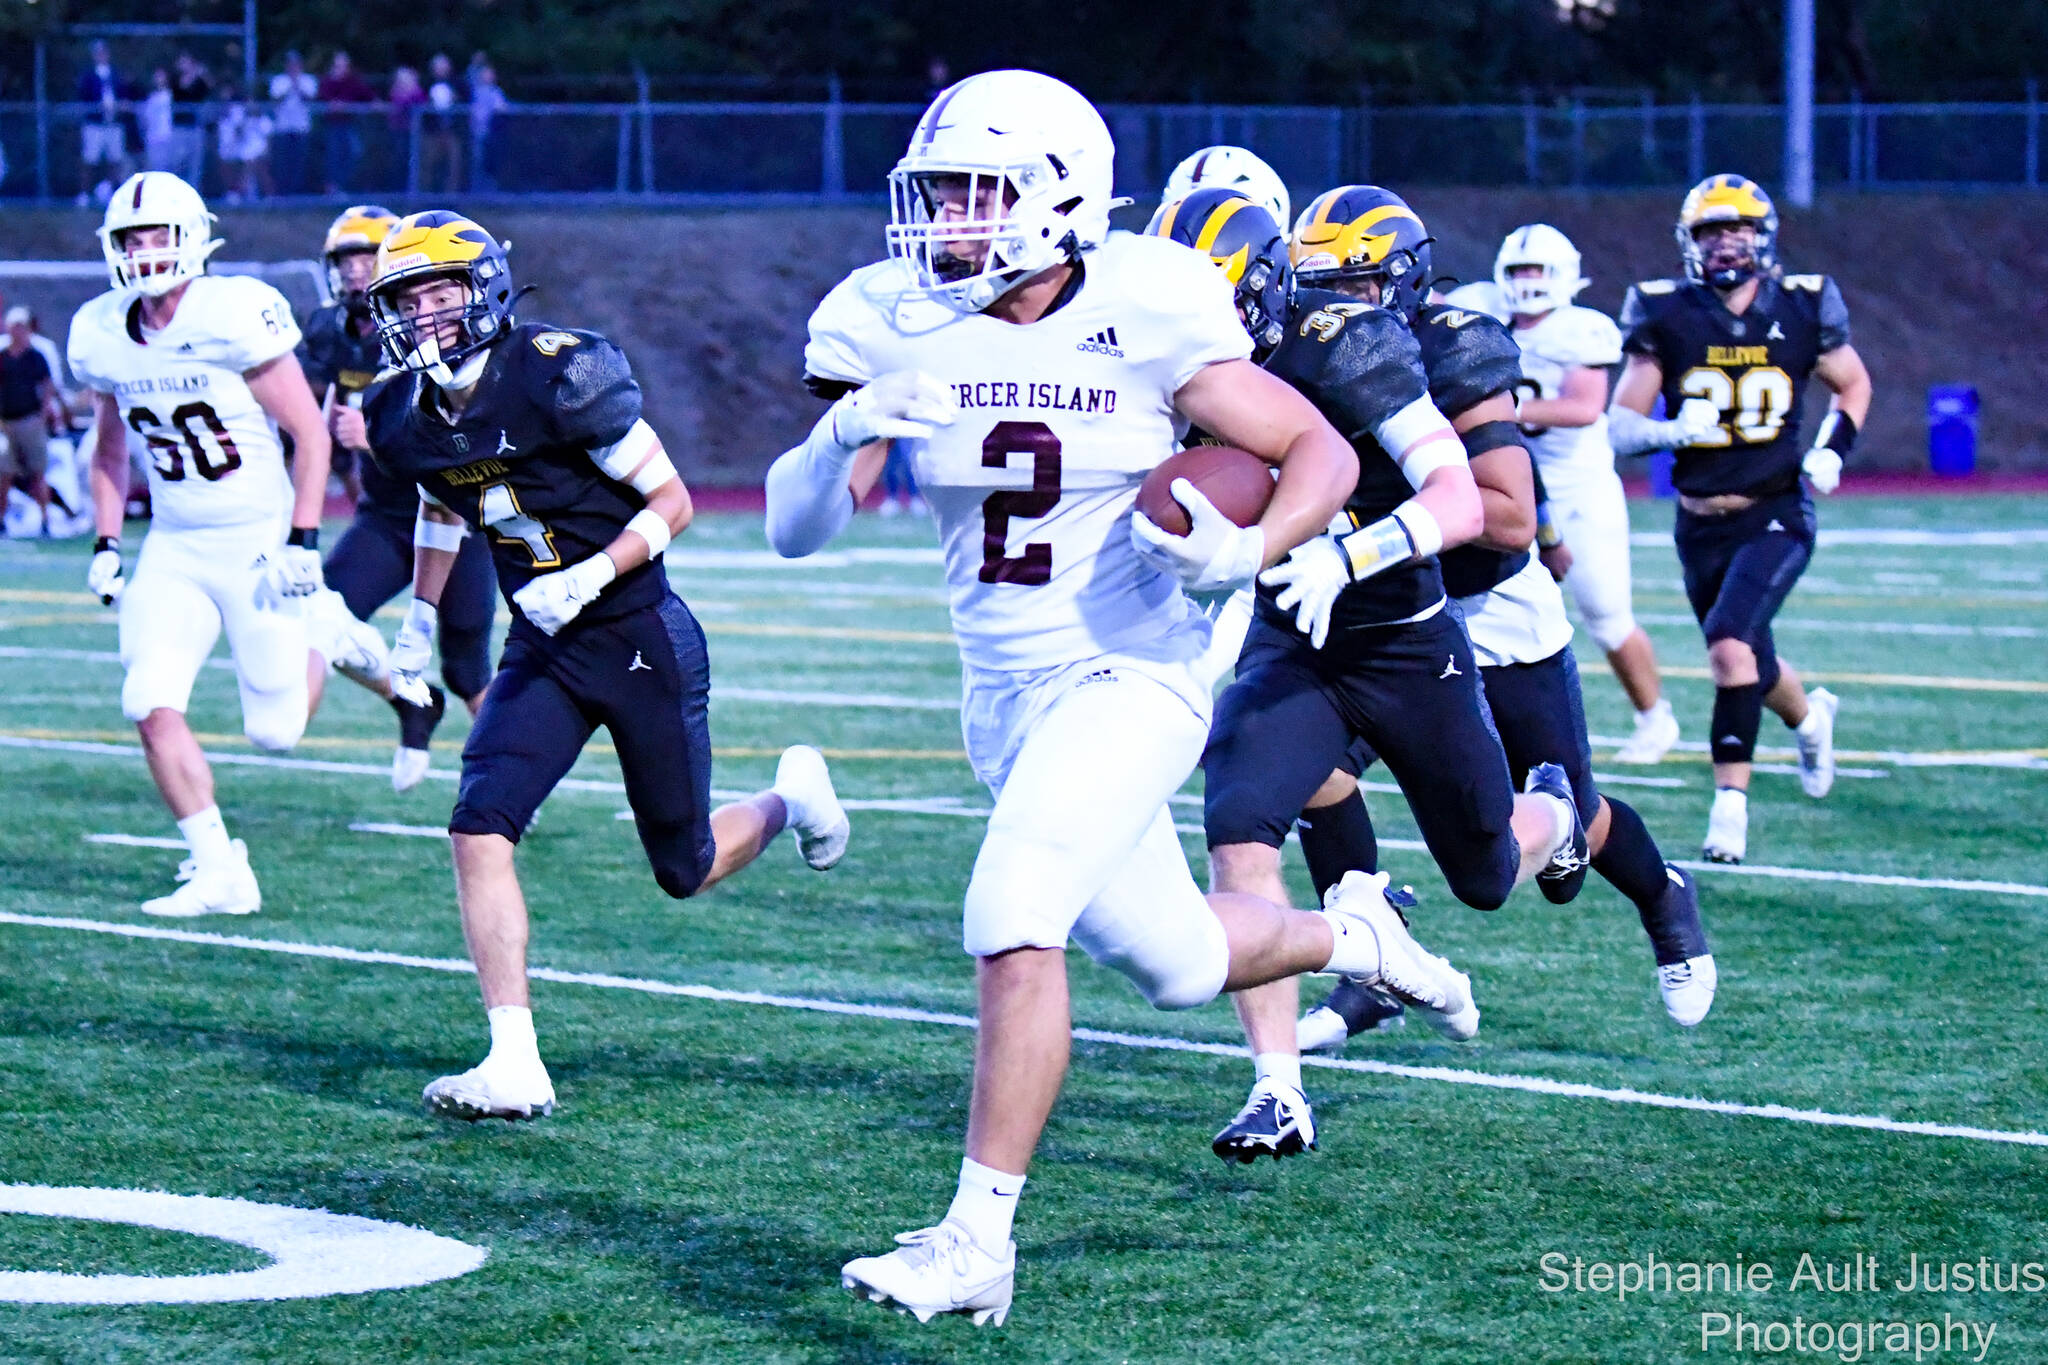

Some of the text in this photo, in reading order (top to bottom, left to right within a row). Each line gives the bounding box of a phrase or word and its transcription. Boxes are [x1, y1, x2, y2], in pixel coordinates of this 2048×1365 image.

[532, 332, 581, 357] 4
[1076, 341, 1124, 358] adidas
[158, 374, 209, 393] ISLAND
[950, 382, 1117, 414] RCER ISLAND
[1680, 366, 1794, 448] 20
[128, 401, 242, 482] 60
[440, 459, 510, 486] BELLEVUE
[978, 420, 1062, 587] 2
[479, 480, 561, 567] 4
